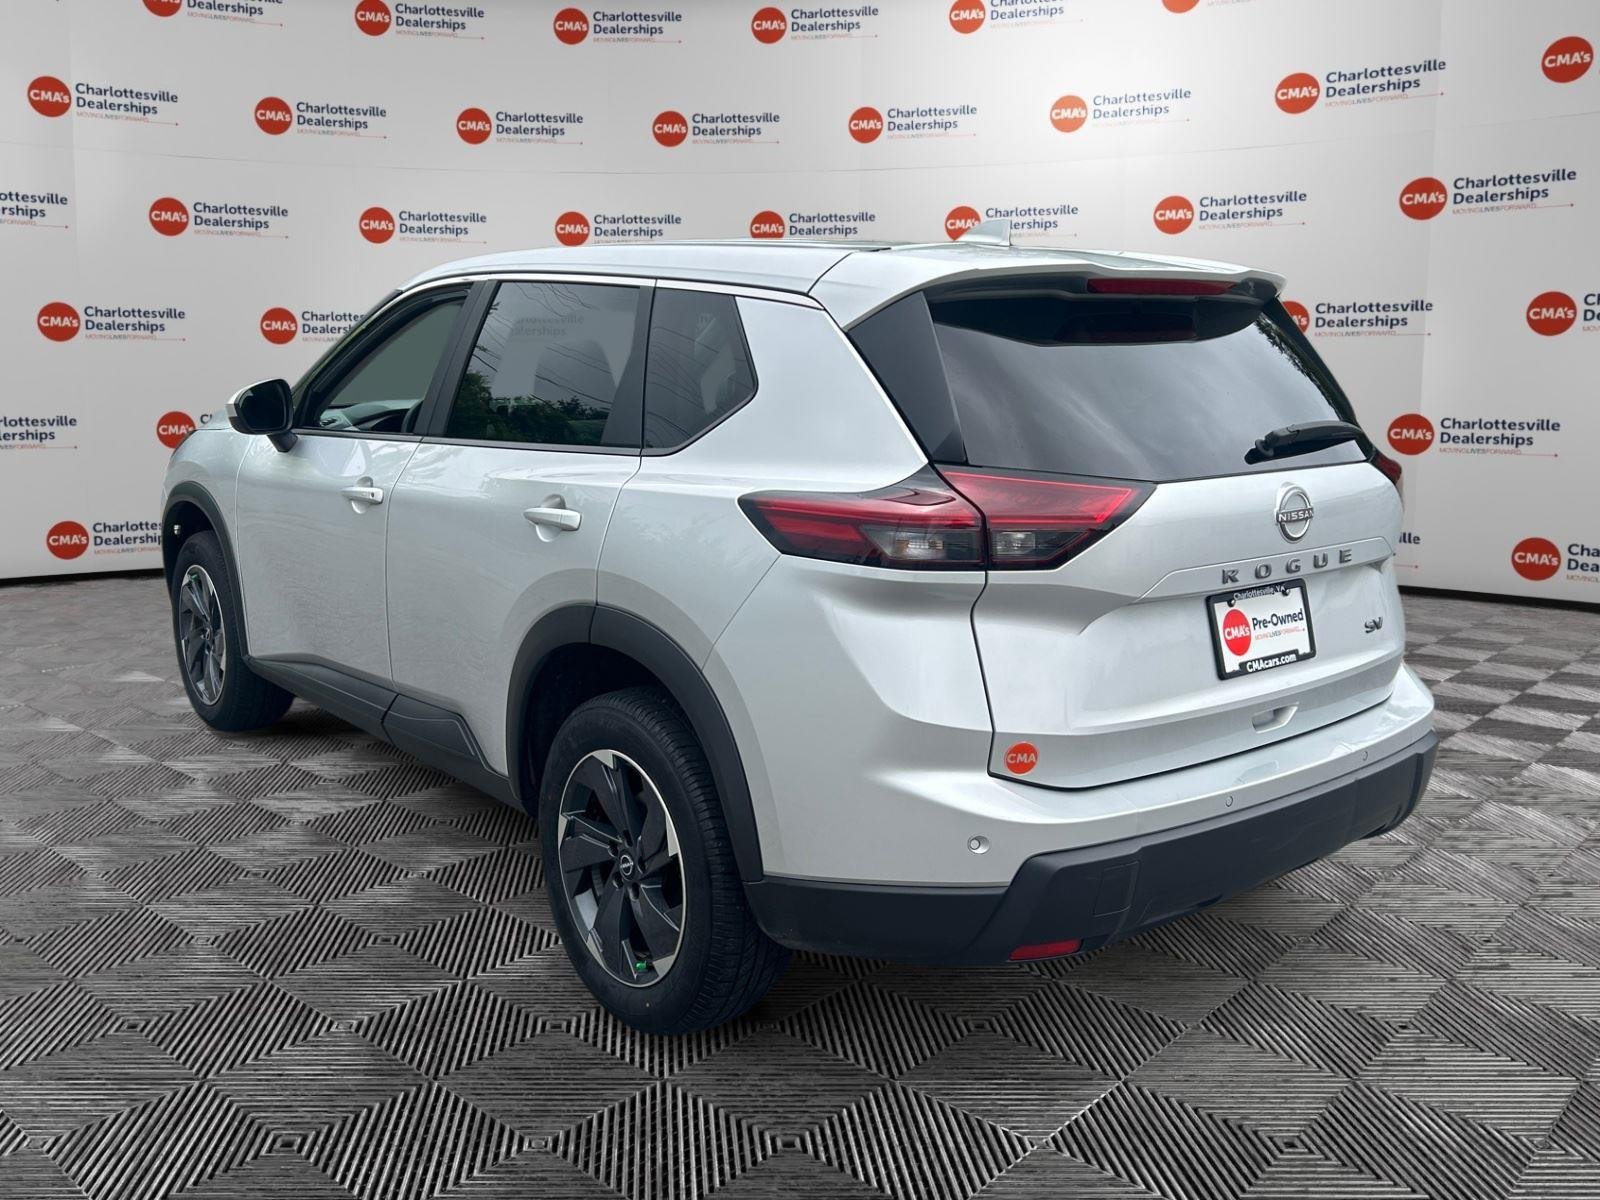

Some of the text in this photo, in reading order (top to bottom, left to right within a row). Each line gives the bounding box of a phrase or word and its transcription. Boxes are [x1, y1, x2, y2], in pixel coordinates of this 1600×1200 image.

[186, 0, 263, 16] Dealerships
[395, 3, 485, 18] Charlottesville
[791, 6, 879, 19] Charlottesville
[990, 4, 1064, 21] Dealerships
[356, 10, 390, 23] CMA's
[593, 11, 683, 22] Charlottesville
[950, 9, 985, 21] CMA's
[395, 16, 466, 32] Dealerships
[555, 21, 589, 32] CMA's
[593, 24, 664, 35] Dealerships
[752, 20, 787, 32] CMA's
[791, 20, 860, 33] Dealerships
[1544, 50, 1591, 68] CMA's
[1326, 59, 1447, 83] Charlottesville
[75, 83, 179, 103] Charlottesville
[1276, 85, 1318, 100] CMA's
[1325, 77, 1420, 98] Dealerships
[30, 89, 70, 104] CMA's
[1093, 89, 1191, 106] Charlottesville
[76, 96, 158, 115] Dealerships
[297, 102, 388, 118] Charlottesville
[887, 105, 977, 119] Charlottesville
[1093, 104, 1170, 120] Dealerships
[256, 110, 292, 122] CMA's
[495, 111, 584, 124] Charlottesville
[692, 113, 781, 124] Charlottesville
[1052, 107, 1087, 120] CMA's
[297, 115, 369, 130] Dealerships
[458, 121, 491, 132] CMA's
[850, 119, 883, 131] CMA's
[887, 118, 958, 132] Dealerships
[496, 124, 565, 136] Dealerships
[654, 124, 687, 135] CMA's
[692, 126, 762, 137] Dealerships
[1453, 168, 1577, 190] Charlottesville
[1199, 191, 1307, 208] Charlottesville
[1400, 192, 1447, 205] CMA's
[1453, 187, 1549, 206] Dealerships
[193, 201, 289, 218] Charlottesville
[985, 204, 1079, 219] Charlottesville
[1153, 209, 1193, 220] CMA's
[1199, 207, 1283, 222] Dealerships
[150, 211, 188, 223] CMA's
[193, 216, 270, 230] Dealerships
[399, 211, 487, 224] Charlottesville
[594, 213, 682, 225] Charlottesville
[789, 212, 876, 224] Charlottesville
[360, 219, 394, 231] CMA's
[399, 223, 469, 236] Dealerships
[556, 224, 589, 235] CMA's
[751, 223, 785, 234] CMA's
[789, 224, 859, 237] Dealerships
[594, 227, 664, 238] Dealerships
[84, 306, 185, 320] Charlottesville
[1315, 299, 1433, 315] Charlottesville
[1529, 308, 1575, 320] CMA's
[40, 315, 79, 328] CMA's
[84, 320, 165, 333] Dealerships
[262, 320, 297, 332] CMA's
[1315, 314, 1408, 330] Dealerships
[0, 416, 77, 428] lottesville
[1440, 417, 1561, 433] Charlottesville
[0, 430, 55, 443] erships
[1390, 429, 1432, 441] CMA's
[1439, 432, 1534, 448] Dealerships
[1278, 509, 1314, 522] NISSAN
[92, 521, 162, 534] Charlotte
[48, 534, 88, 546] CMA's
[1514, 551, 1558, 566] CMA's
[1221, 549, 1352, 584] ROGUE
[1252, 608, 1304, 631] Pre-Owned
[1364, 617, 1384, 633] SV
[1224, 626, 1251, 641] CMA's
[1246, 653, 1298, 673] CMAcars.com
[1006, 753, 1037, 764] CMA
